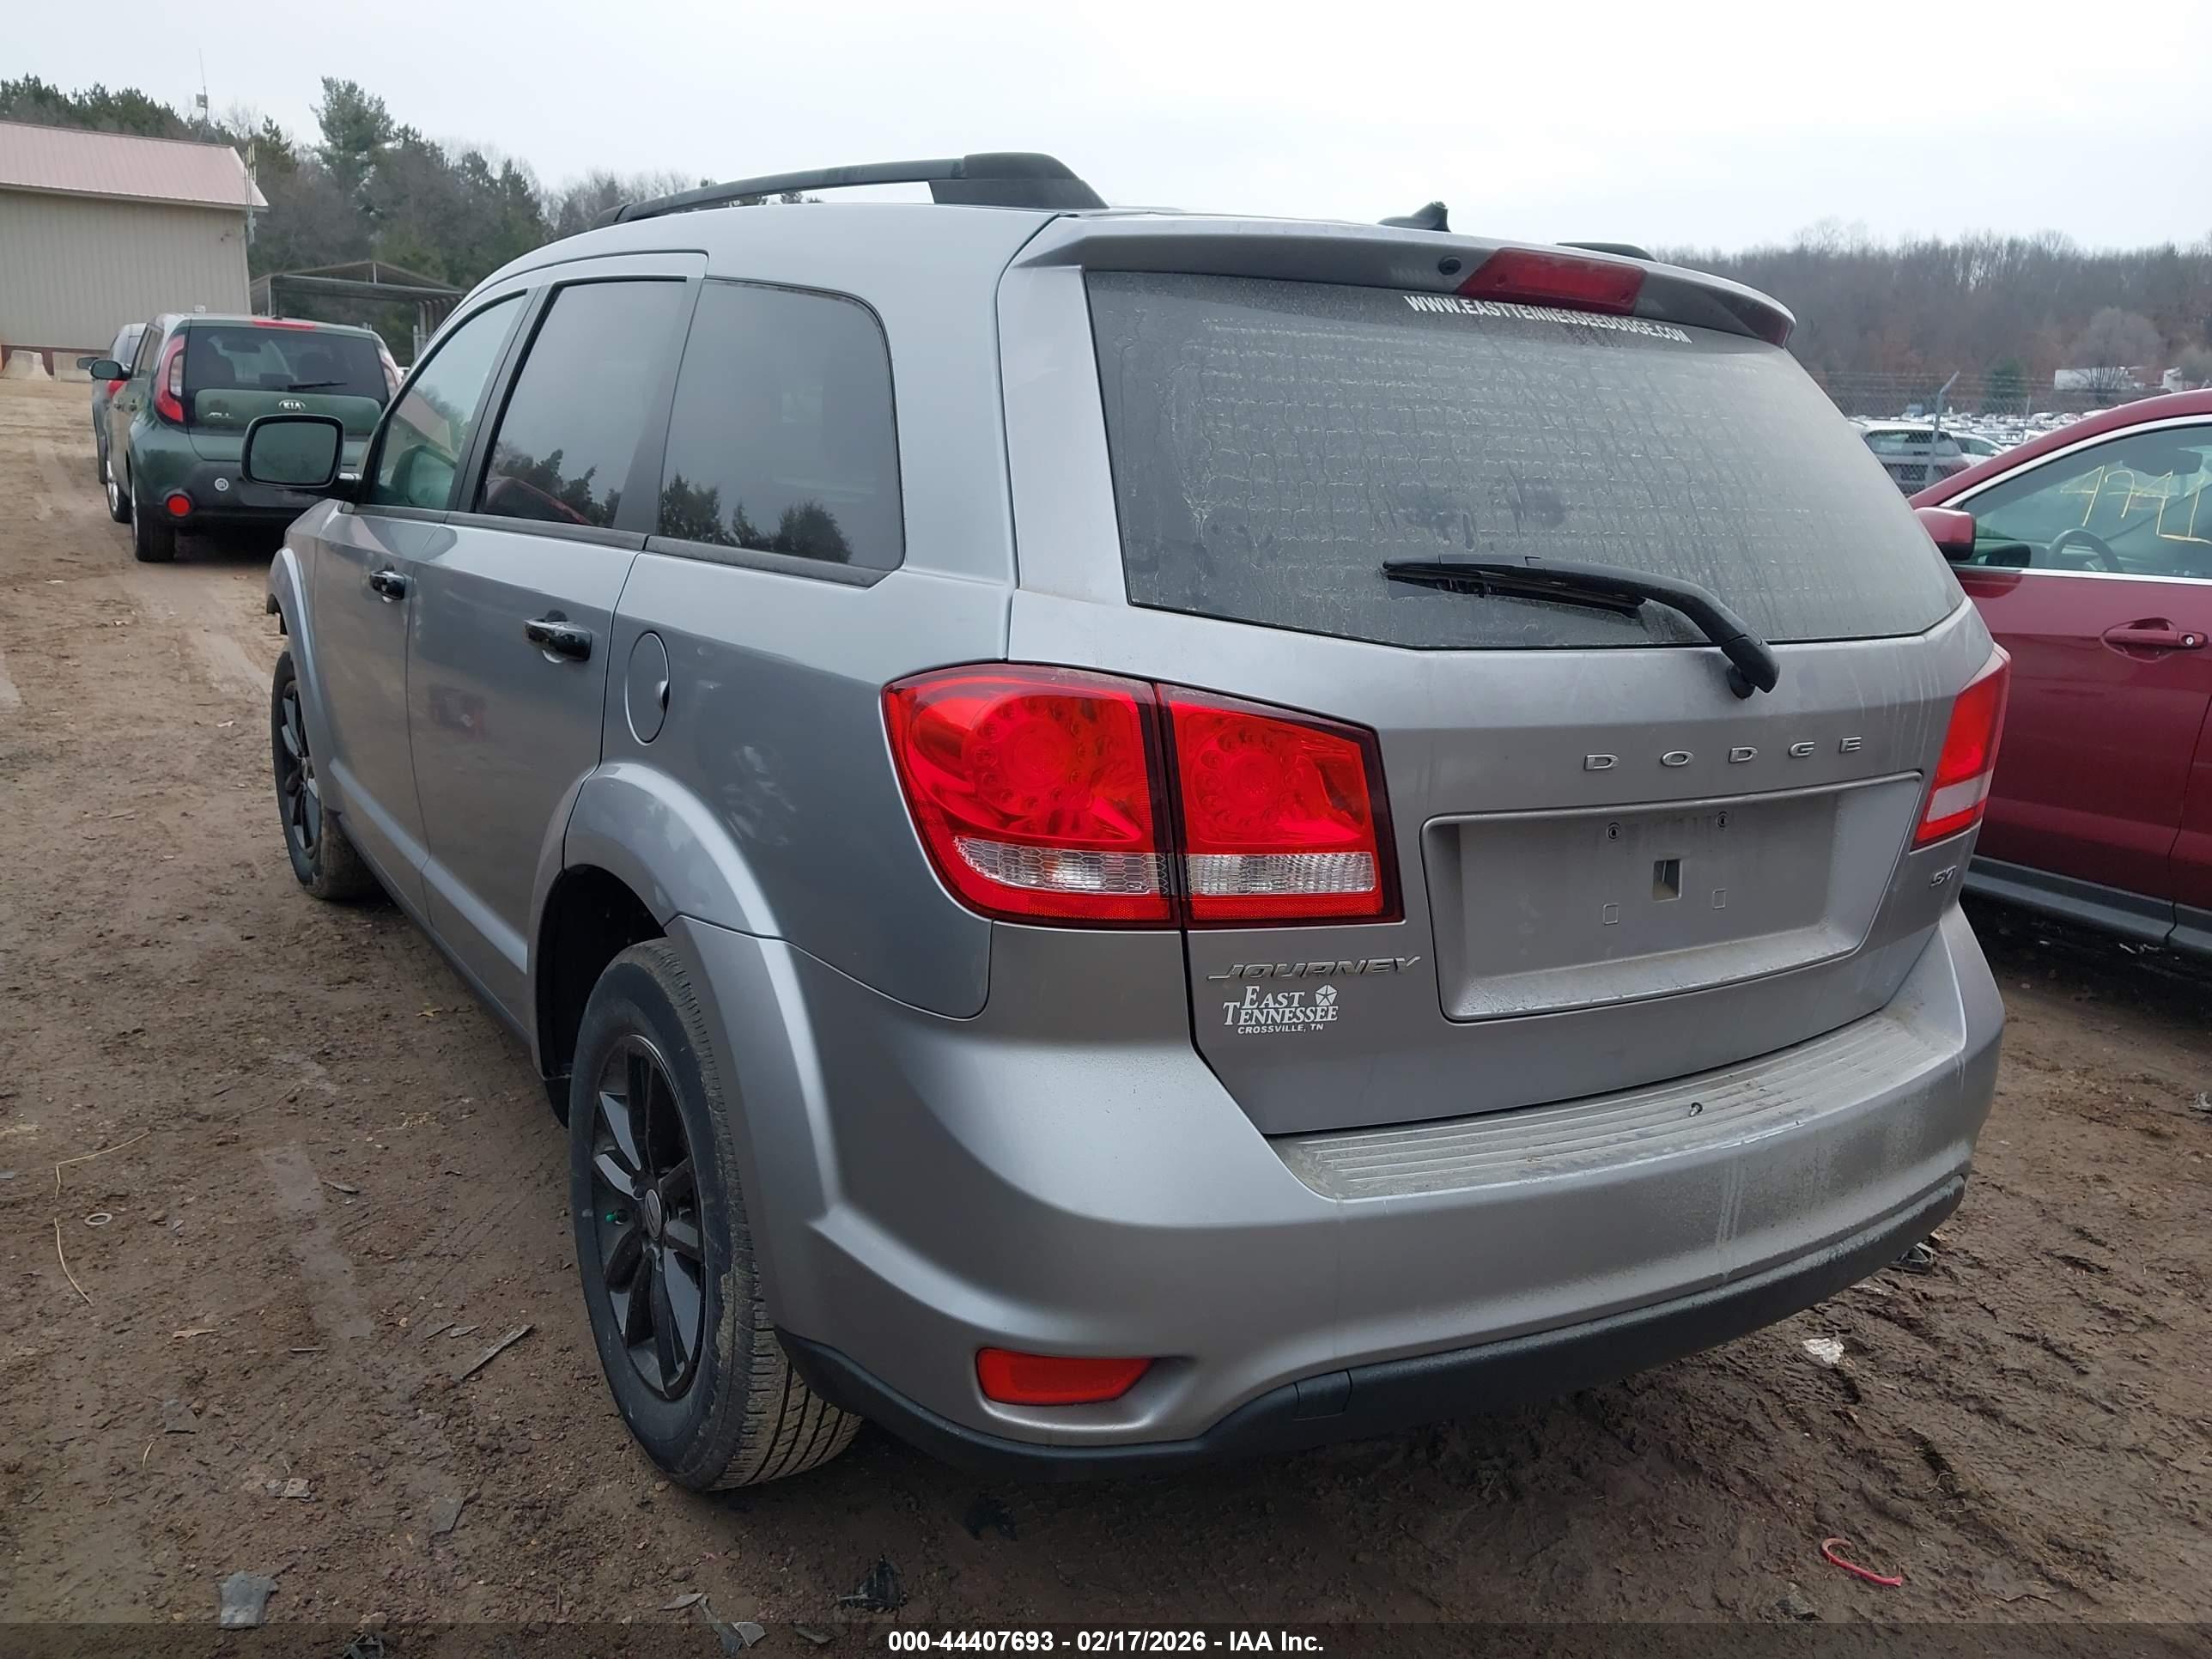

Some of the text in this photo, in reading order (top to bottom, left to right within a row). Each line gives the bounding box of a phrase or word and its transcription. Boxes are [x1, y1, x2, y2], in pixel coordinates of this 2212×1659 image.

[1403, 295, 1692, 343] WWW.EASTTENNESSEEDODGE.COM
[1584, 737, 1863, 769] DODGE
[1207, 956, 1421, 981] JOURNEY
[1237, 1023, 1324, 1035] CROSSVILLE, TN
